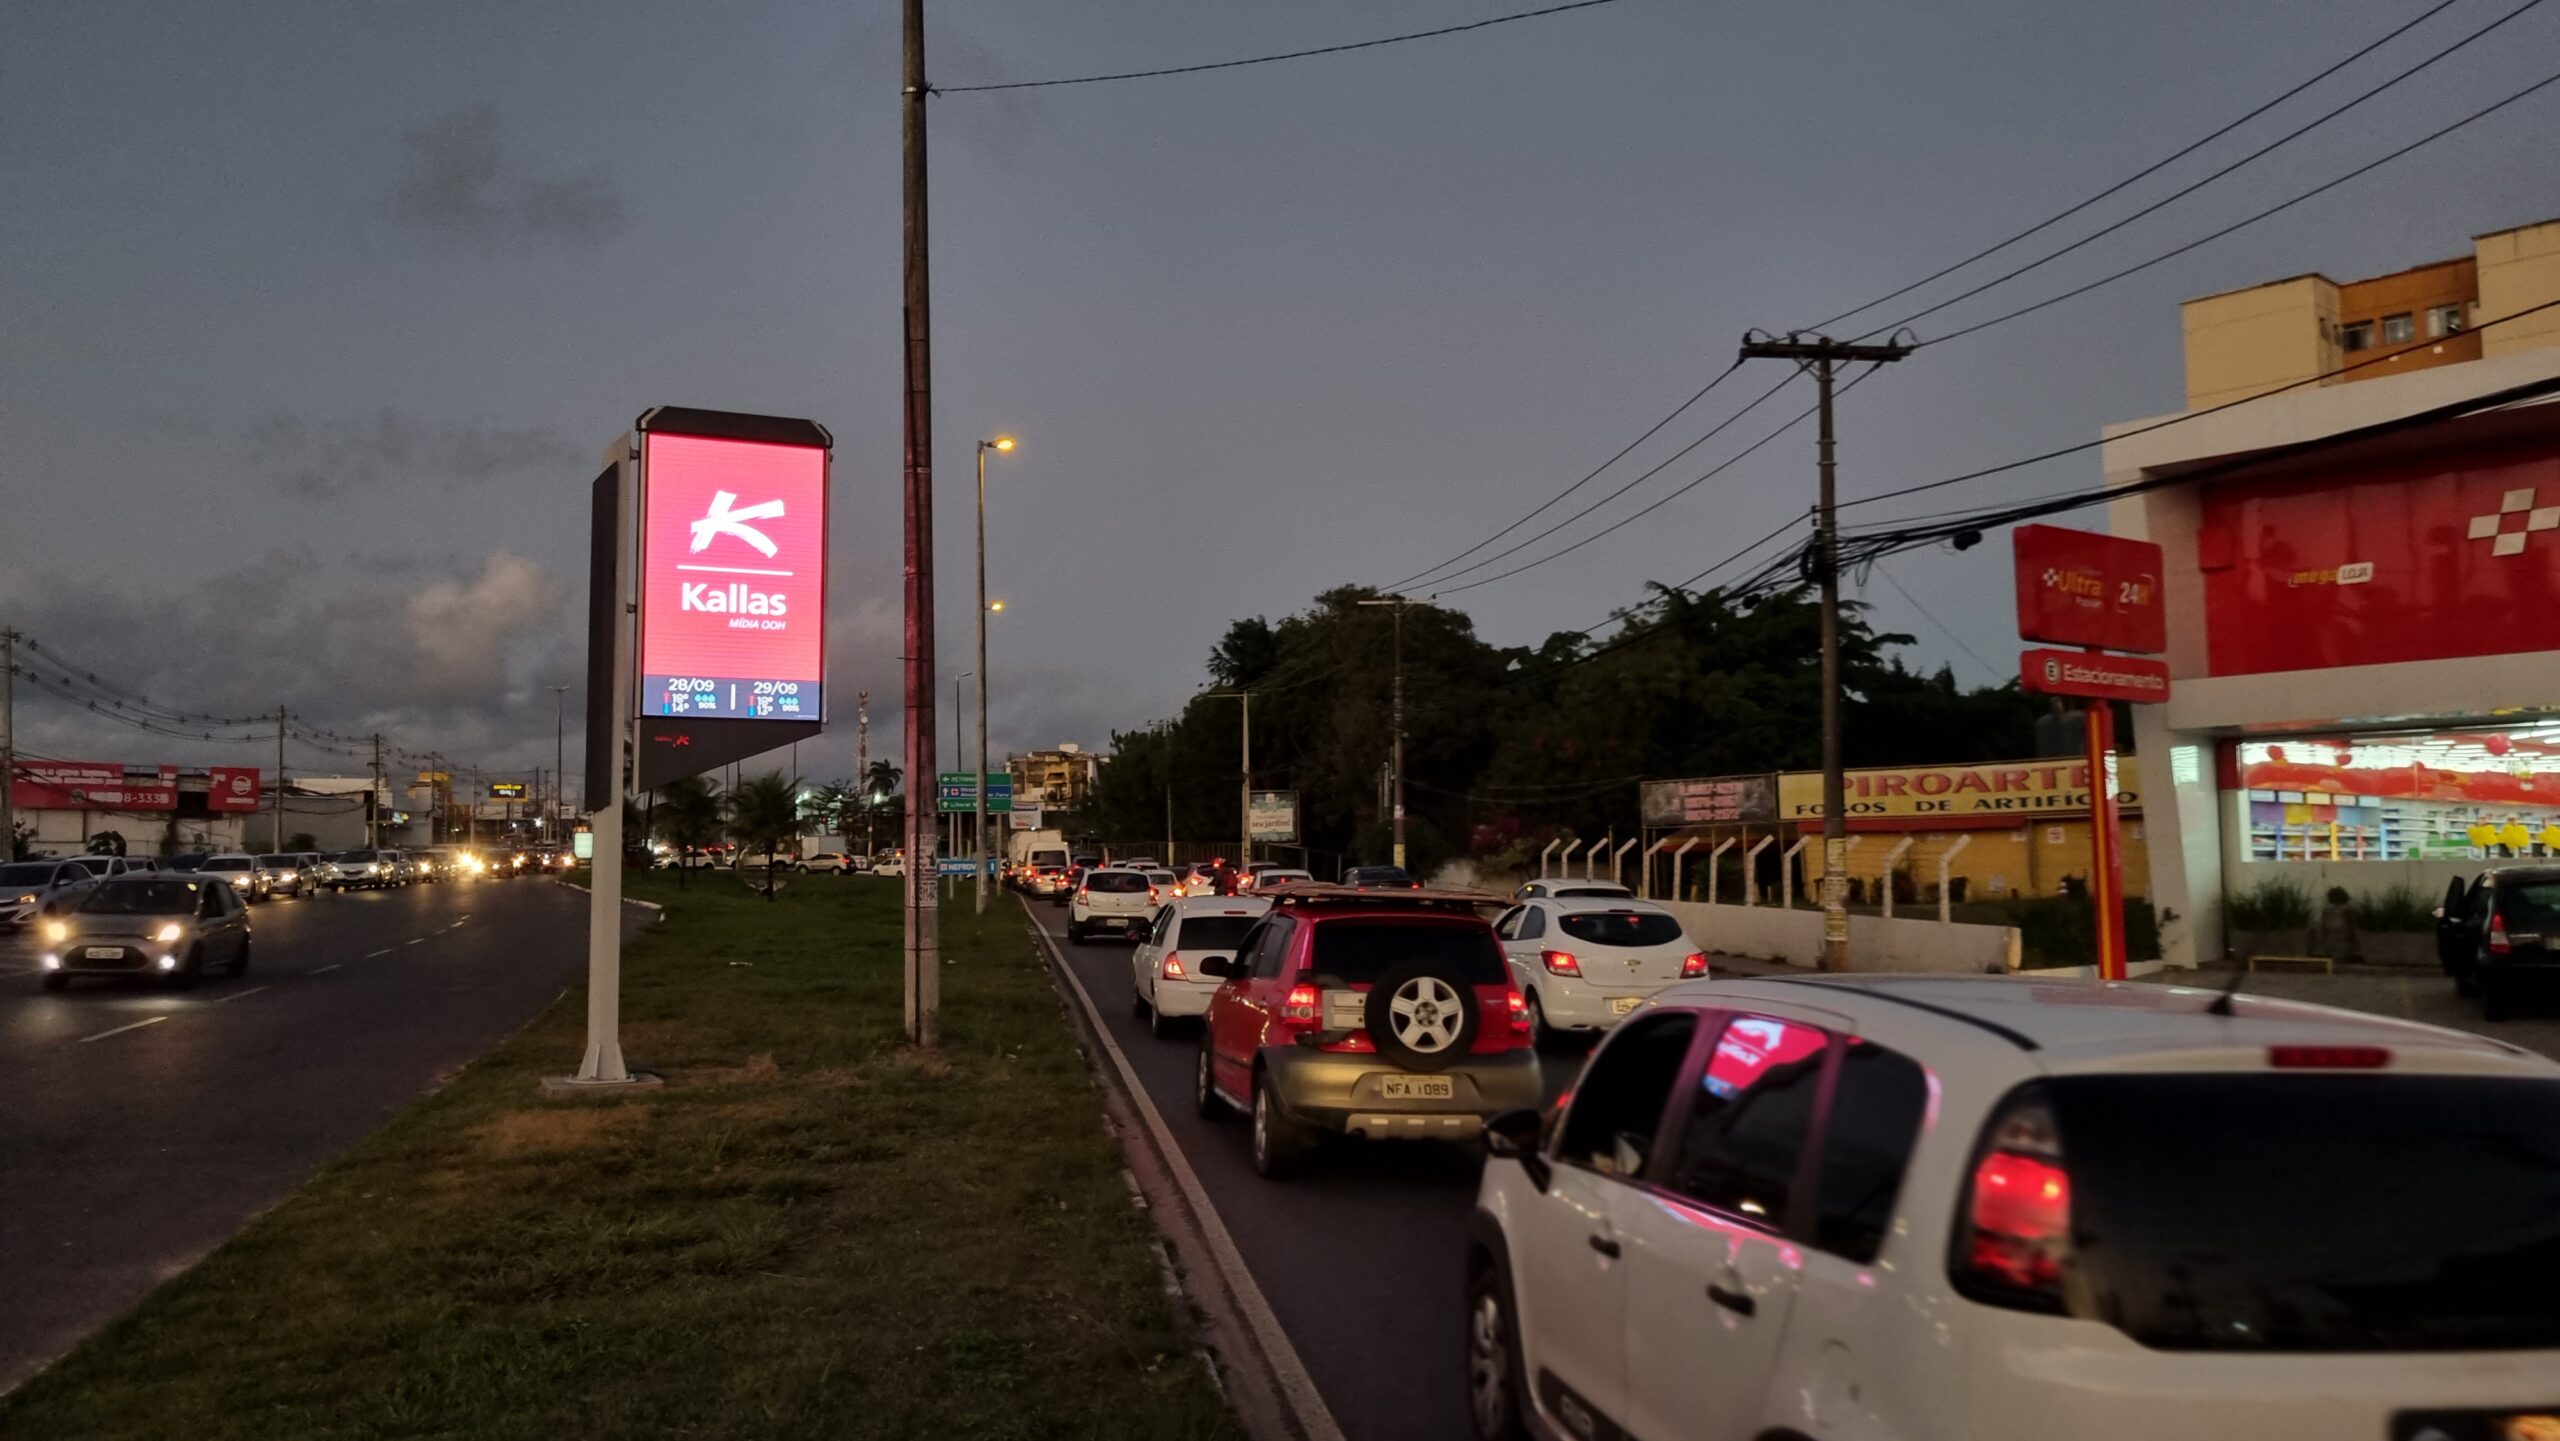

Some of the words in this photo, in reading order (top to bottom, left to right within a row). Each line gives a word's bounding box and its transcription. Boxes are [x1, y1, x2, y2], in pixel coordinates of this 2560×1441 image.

[2058, 570, 2102, 596] Ultra
[681, 582, 787, 616] Kallas
[728, 617, 759, 630] MÍDIA
[761, 619, 786, 631] OOH
[668, 677, 715, 692] 28/09
[2062, 663, 2165, 690] Estacionamento
[753, 681, 798, 696] 29/09
[1796, 801, 1886, 816] FOOS
[1915, 799, 1951, 812] DE
[1973, 790, 2137, 809] ARTIFÍCO
[1386, 1083, 1411, 1095] NFA
